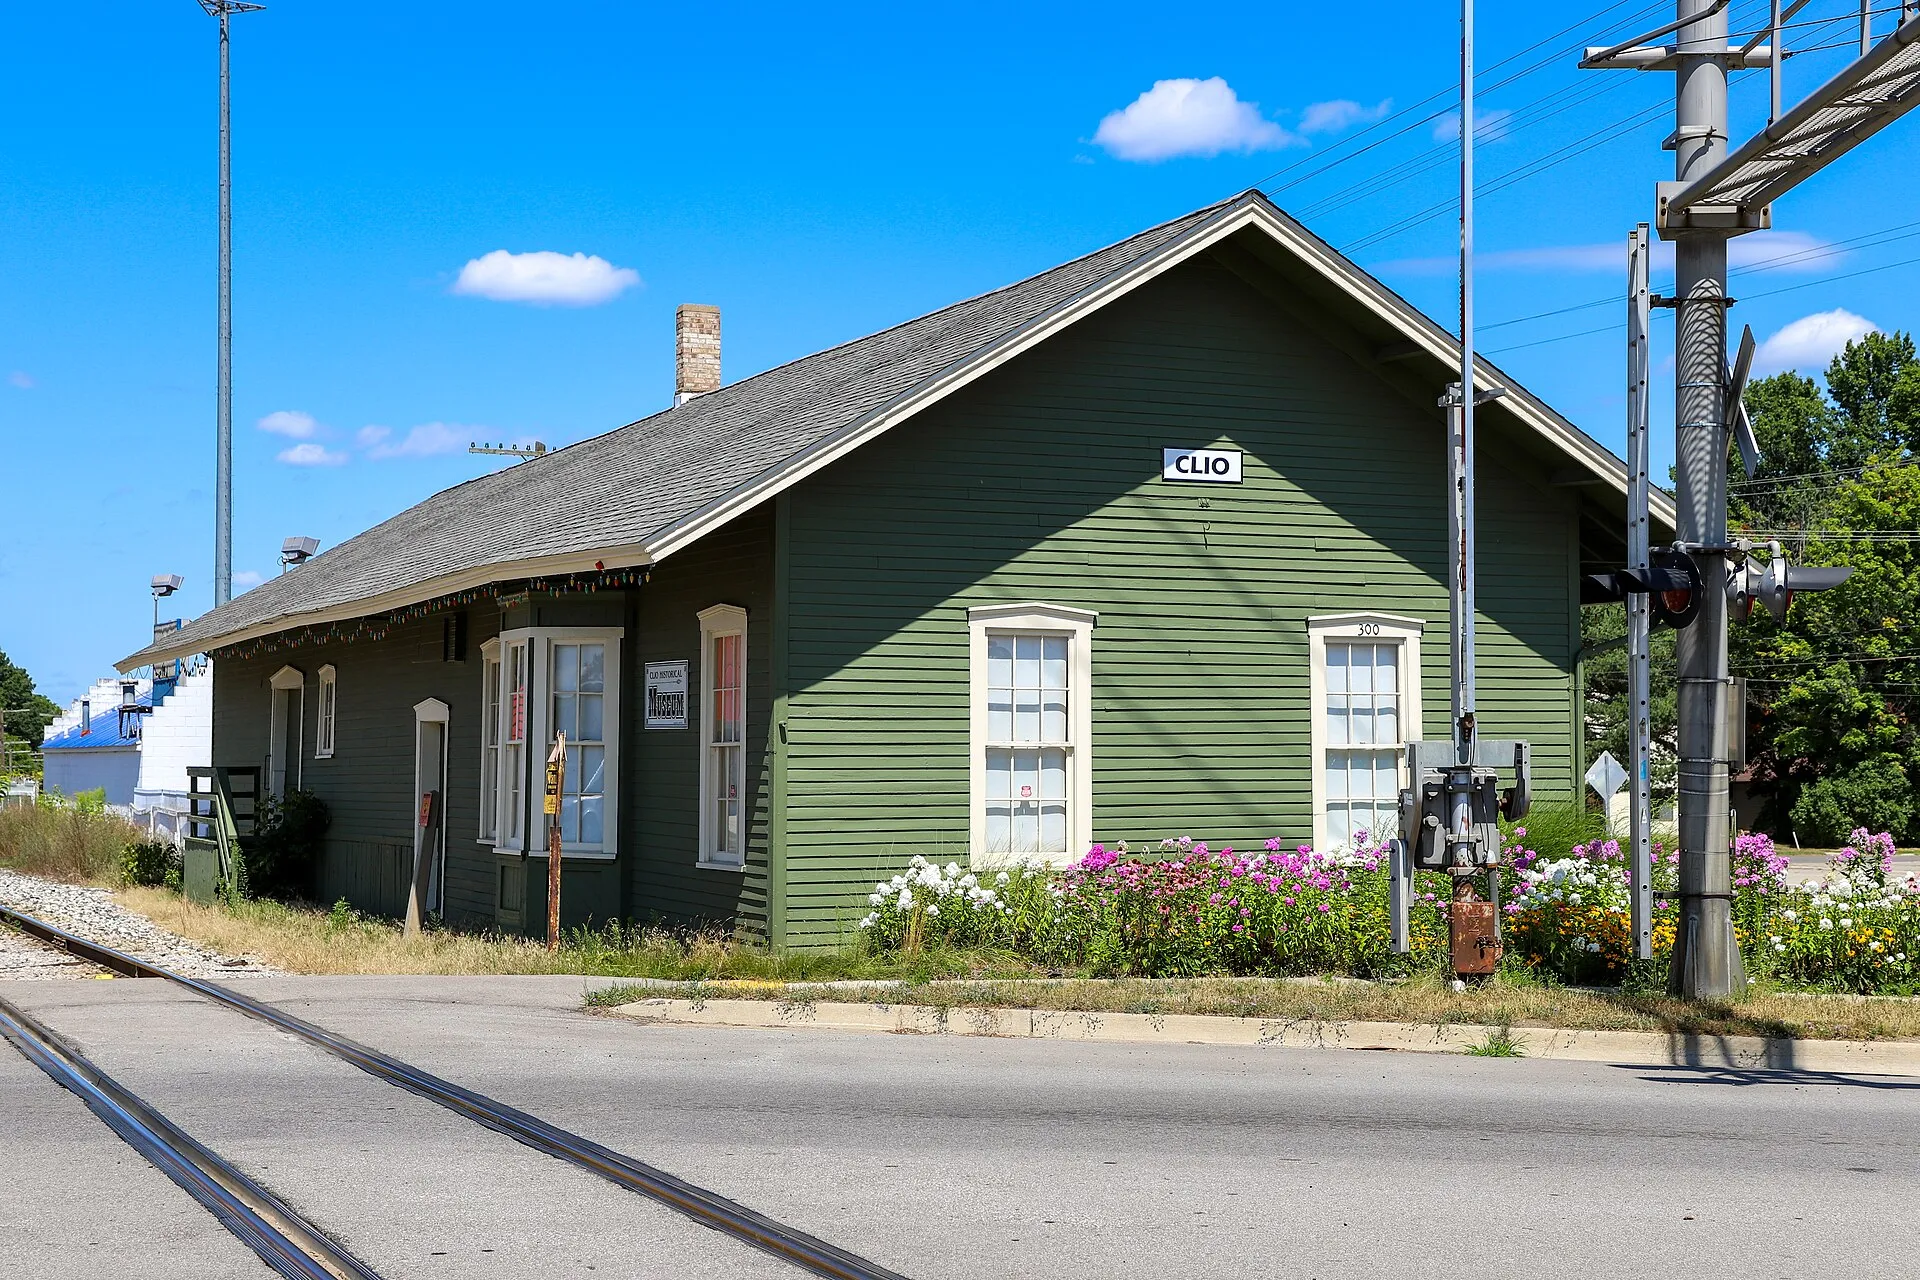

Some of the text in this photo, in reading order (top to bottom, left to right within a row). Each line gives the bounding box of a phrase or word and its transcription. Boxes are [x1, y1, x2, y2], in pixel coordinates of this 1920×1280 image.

[1175, 455, 1230, 476] CLIO
[1358, 623, 1380, 636] 300
[649, 669, 683, 680] CLIO HISTORICAL
[648, 685, 685, 720] MUSEUM
